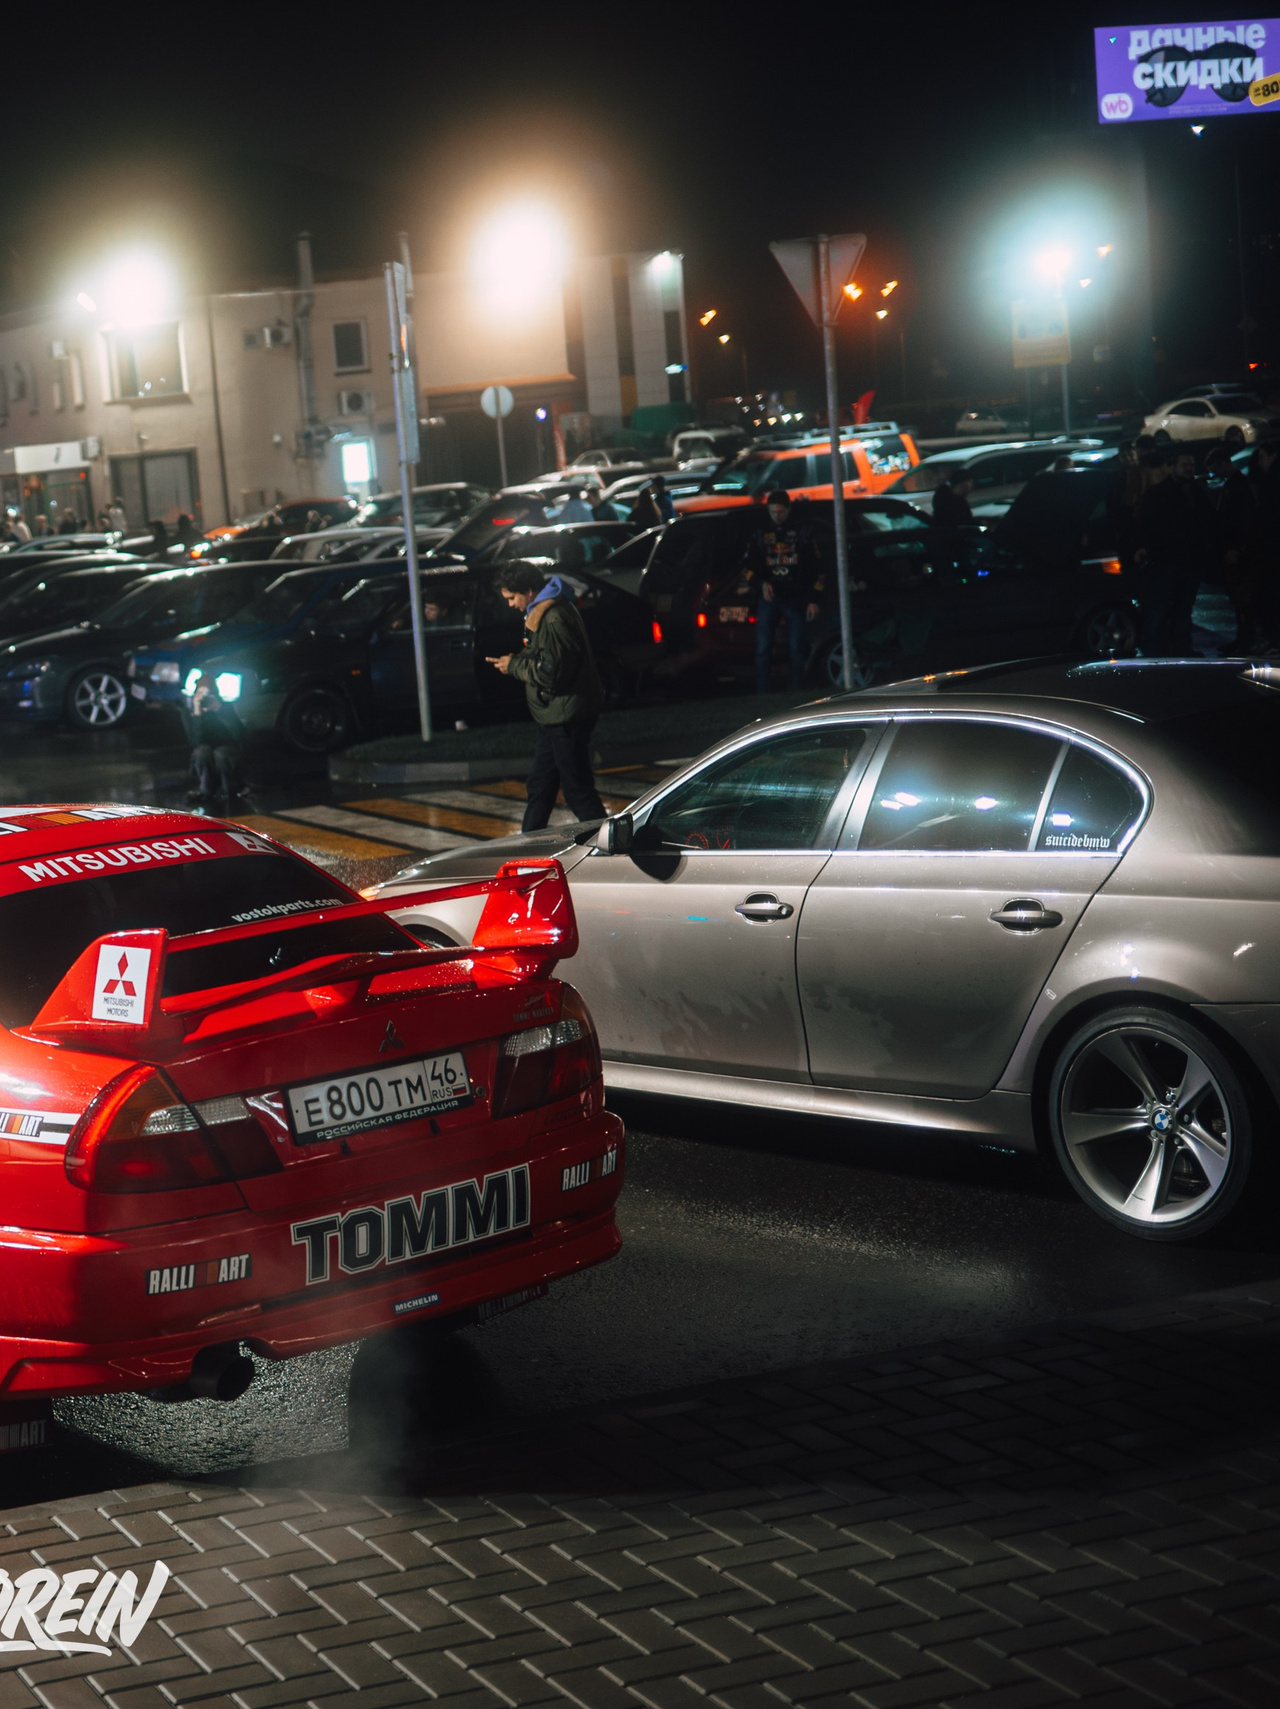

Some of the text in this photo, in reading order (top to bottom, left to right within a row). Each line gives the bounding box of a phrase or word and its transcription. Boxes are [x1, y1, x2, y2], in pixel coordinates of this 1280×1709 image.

[1133, 57, 1265, 90] скидки
[1262, 80, 1280, 97] 80
[18, 837, 216, 883] MITSUBISHI
[231, 896, 344, 923] vostokparts.com
[430, 1057, 457, 1085] 46
[432, 1086, 453, 1099] RUS
[19, 1115, 40, 1137] ART
[316, 1099, 459, 1138] РОССИЙСКАЯ ФЕДЕРАЦИЯ
[562, 1166, 590, 1191] RALLI
[291, 1163, 531, 1286] TOMMI
[148, 1255, 249, 1294] RALLI ART
[394, 1295, 438, 1312] MICHELIN
